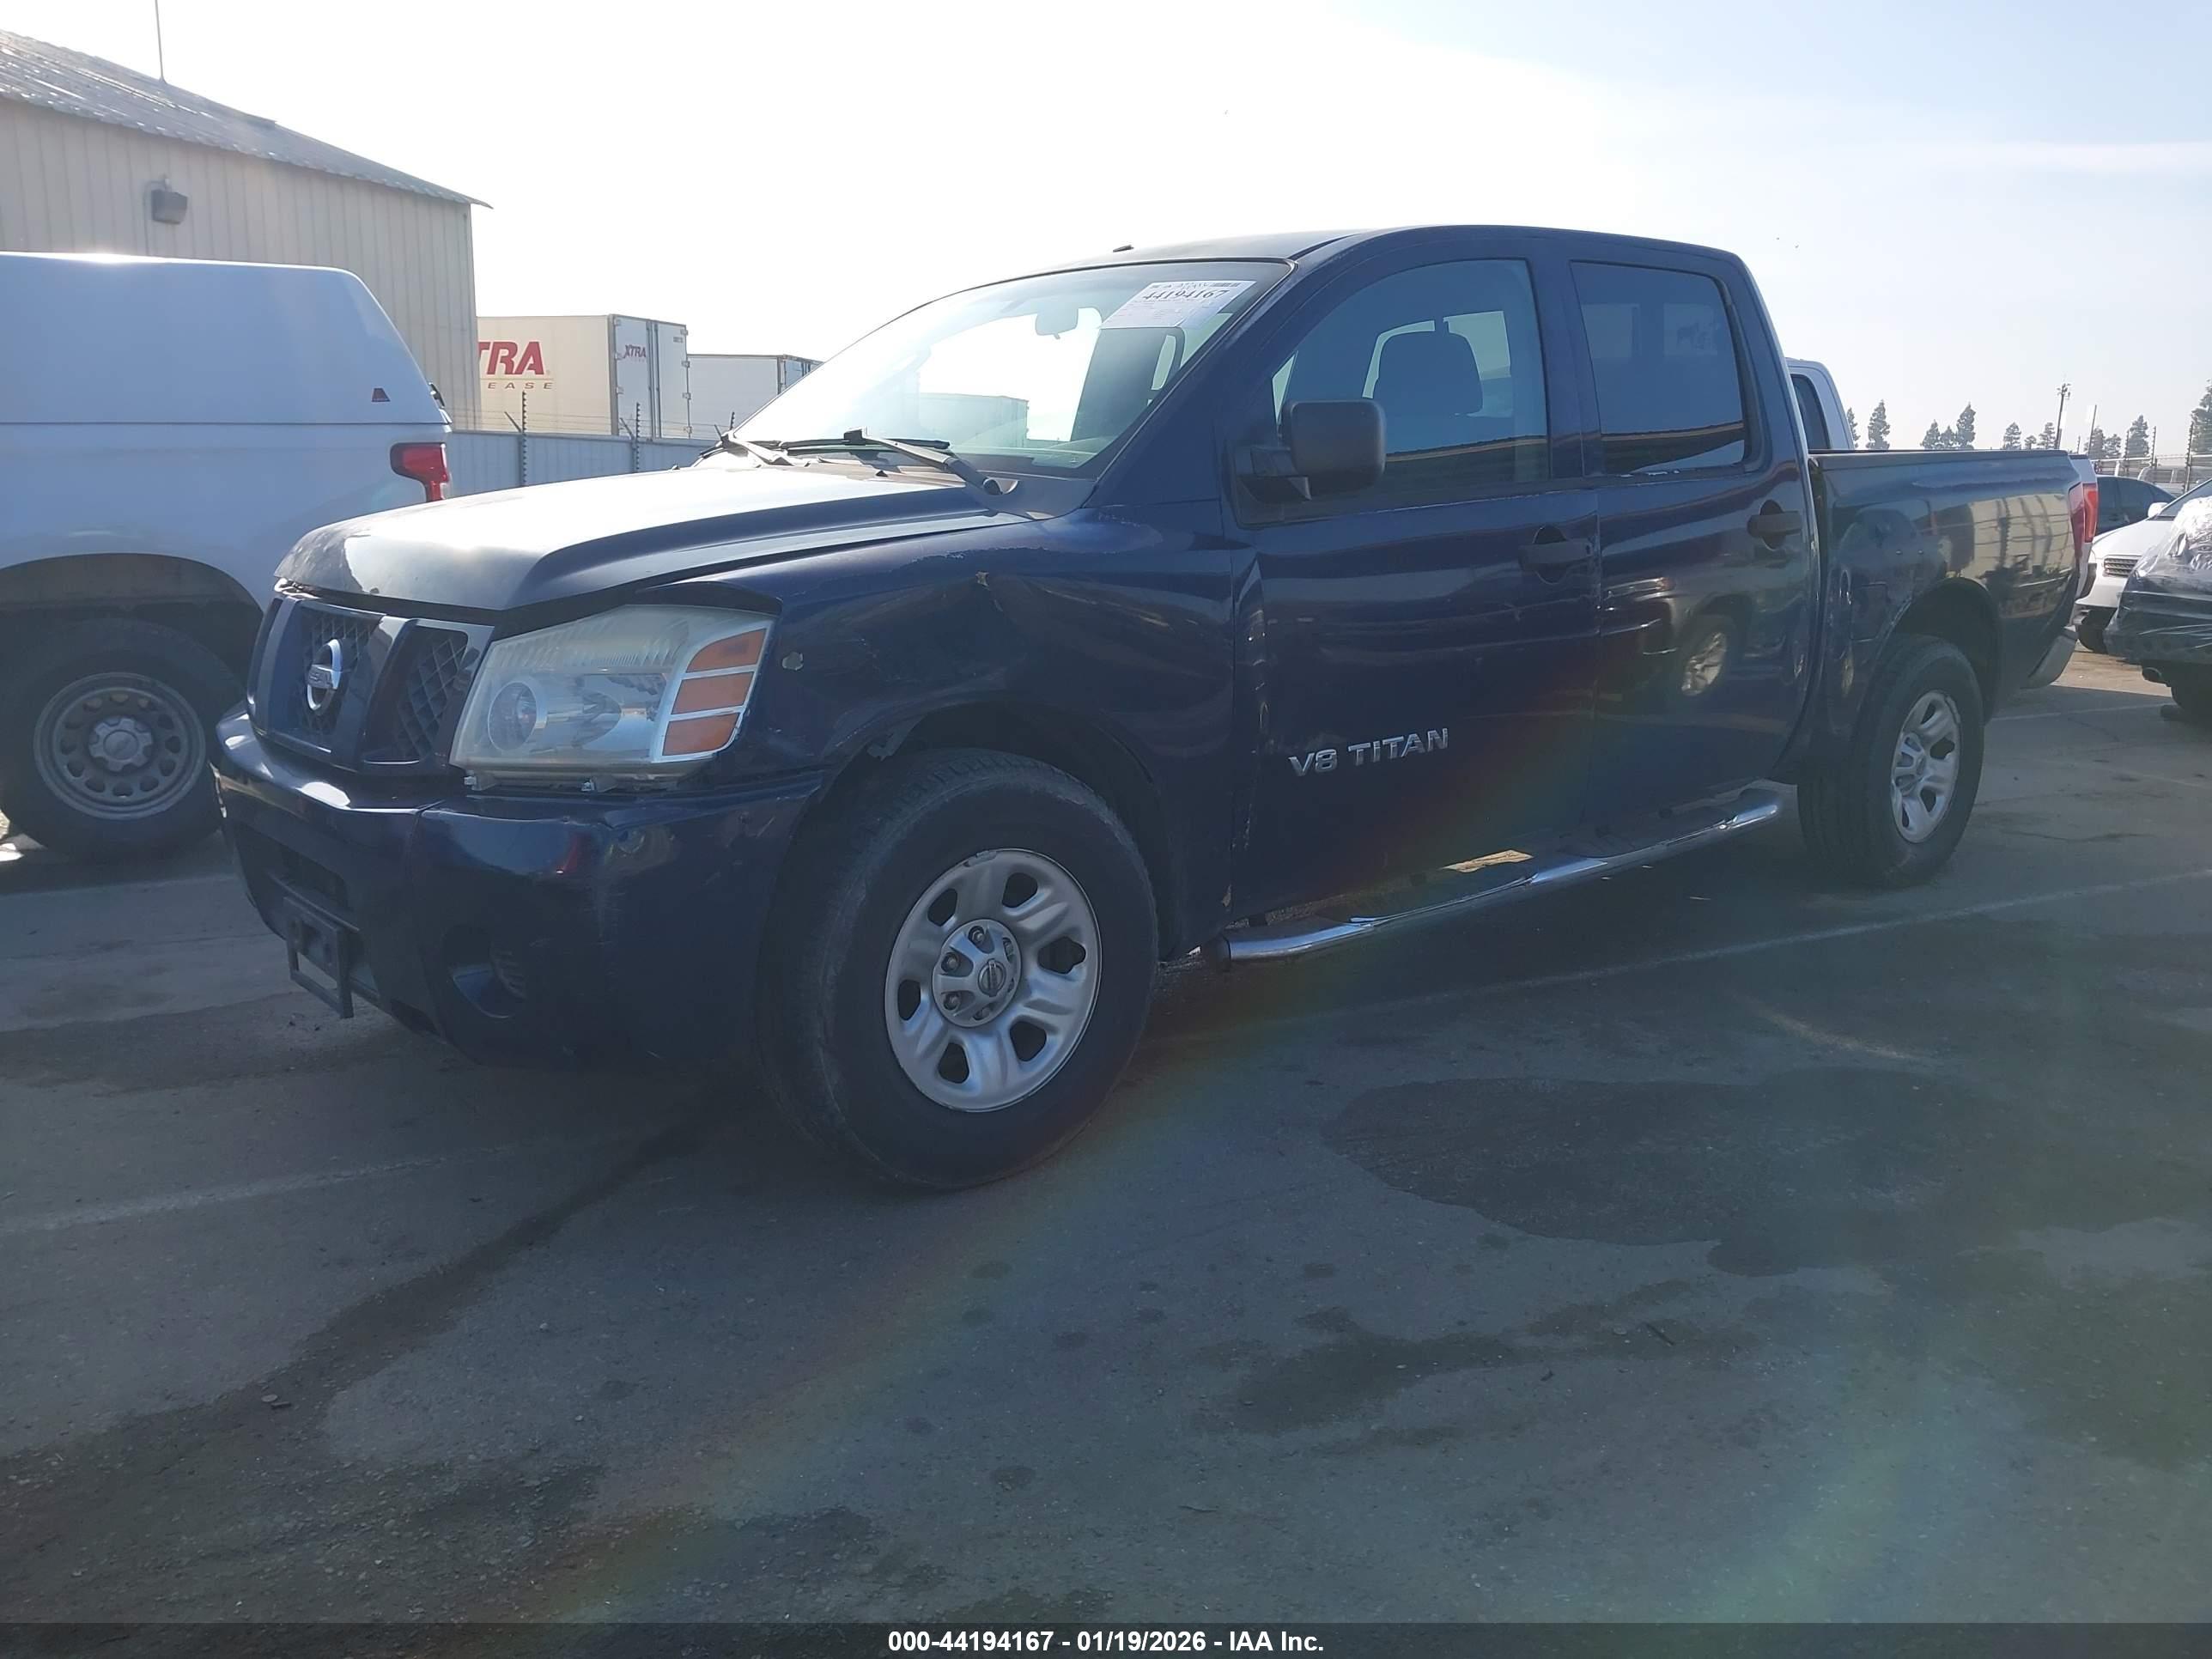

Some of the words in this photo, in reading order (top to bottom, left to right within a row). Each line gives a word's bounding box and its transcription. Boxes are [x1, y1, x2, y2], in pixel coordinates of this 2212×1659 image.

[624, 344, 647, 358] XTRA
[1288, 748, 1338, 777] V8
[1347, 727, 1449, 767] TITAN
